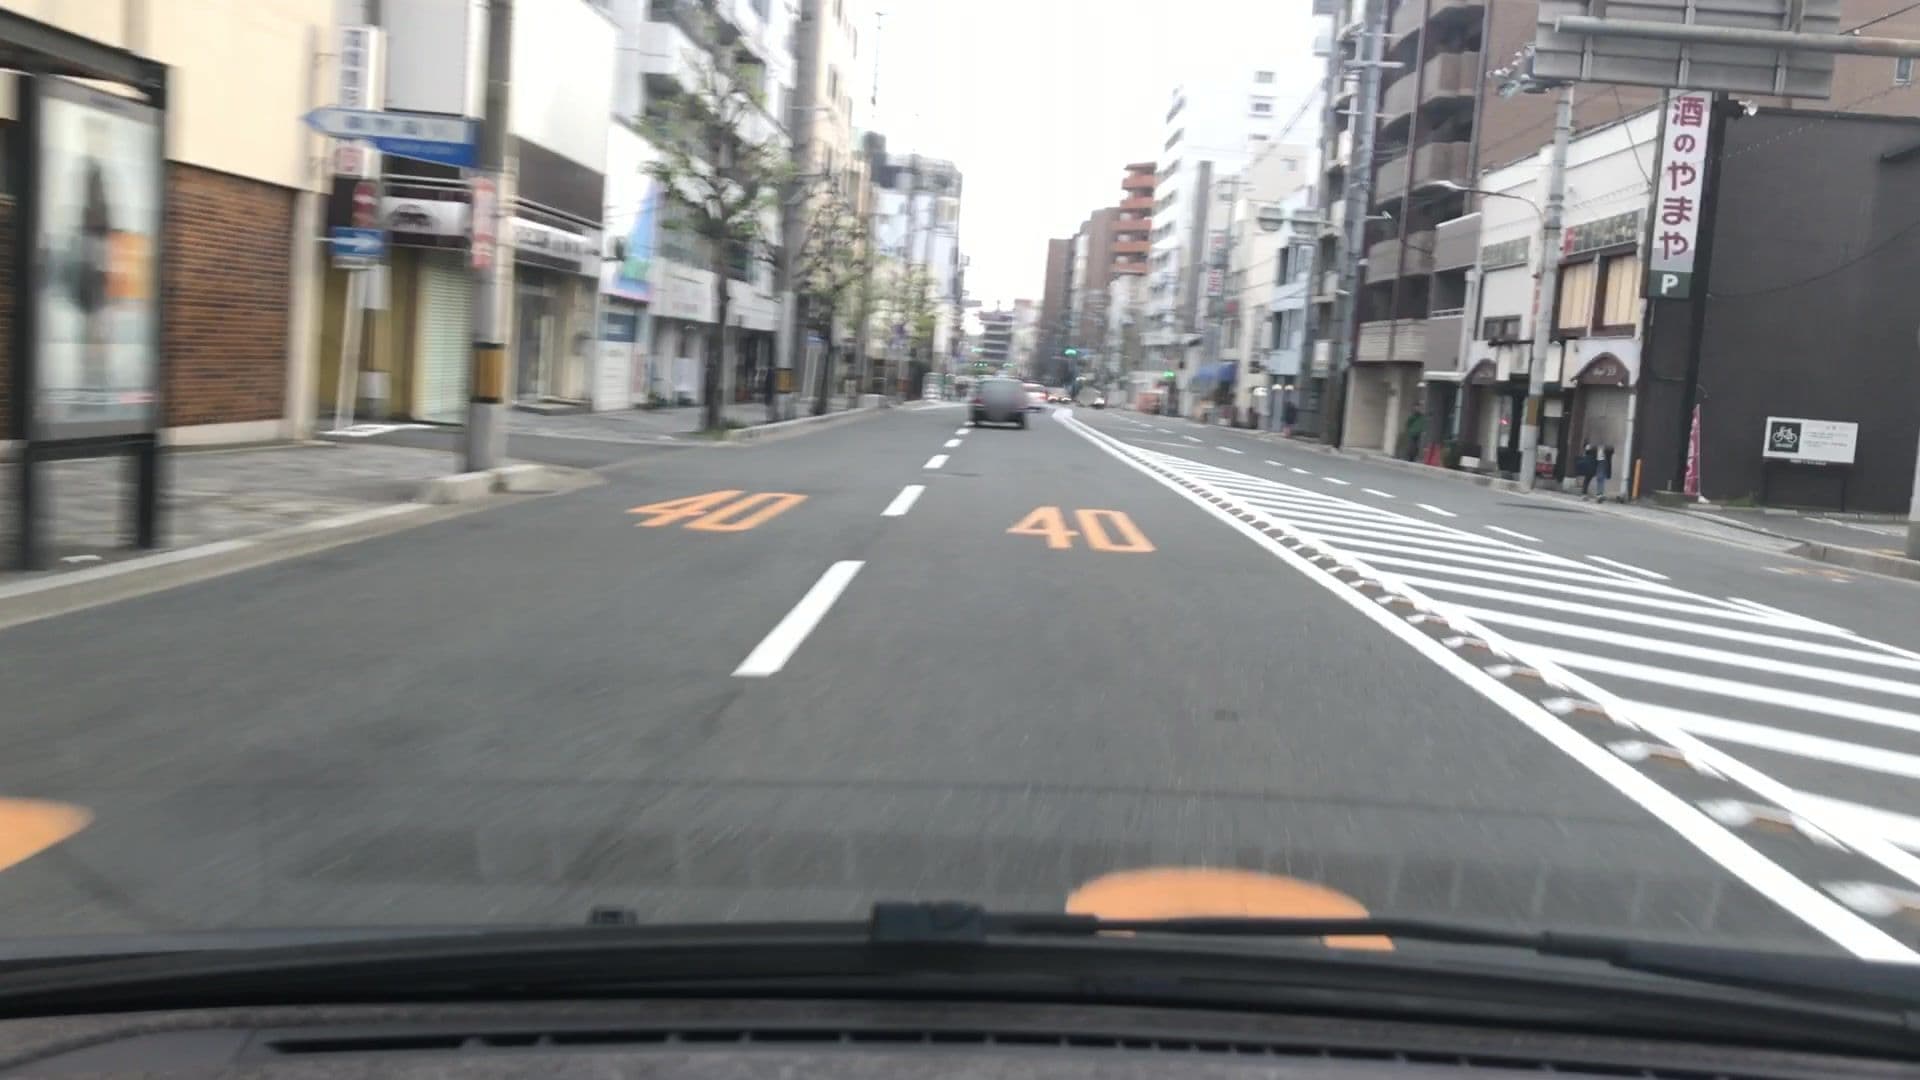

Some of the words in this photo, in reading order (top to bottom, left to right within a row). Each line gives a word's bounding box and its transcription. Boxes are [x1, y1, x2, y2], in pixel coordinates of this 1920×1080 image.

[1659, 95, 1705, 261] 酒のやまや
[1660, 273, 1679, 295] P
[625, 489, 809, 532] 40
[1005, 505, 1156, 553] 40
